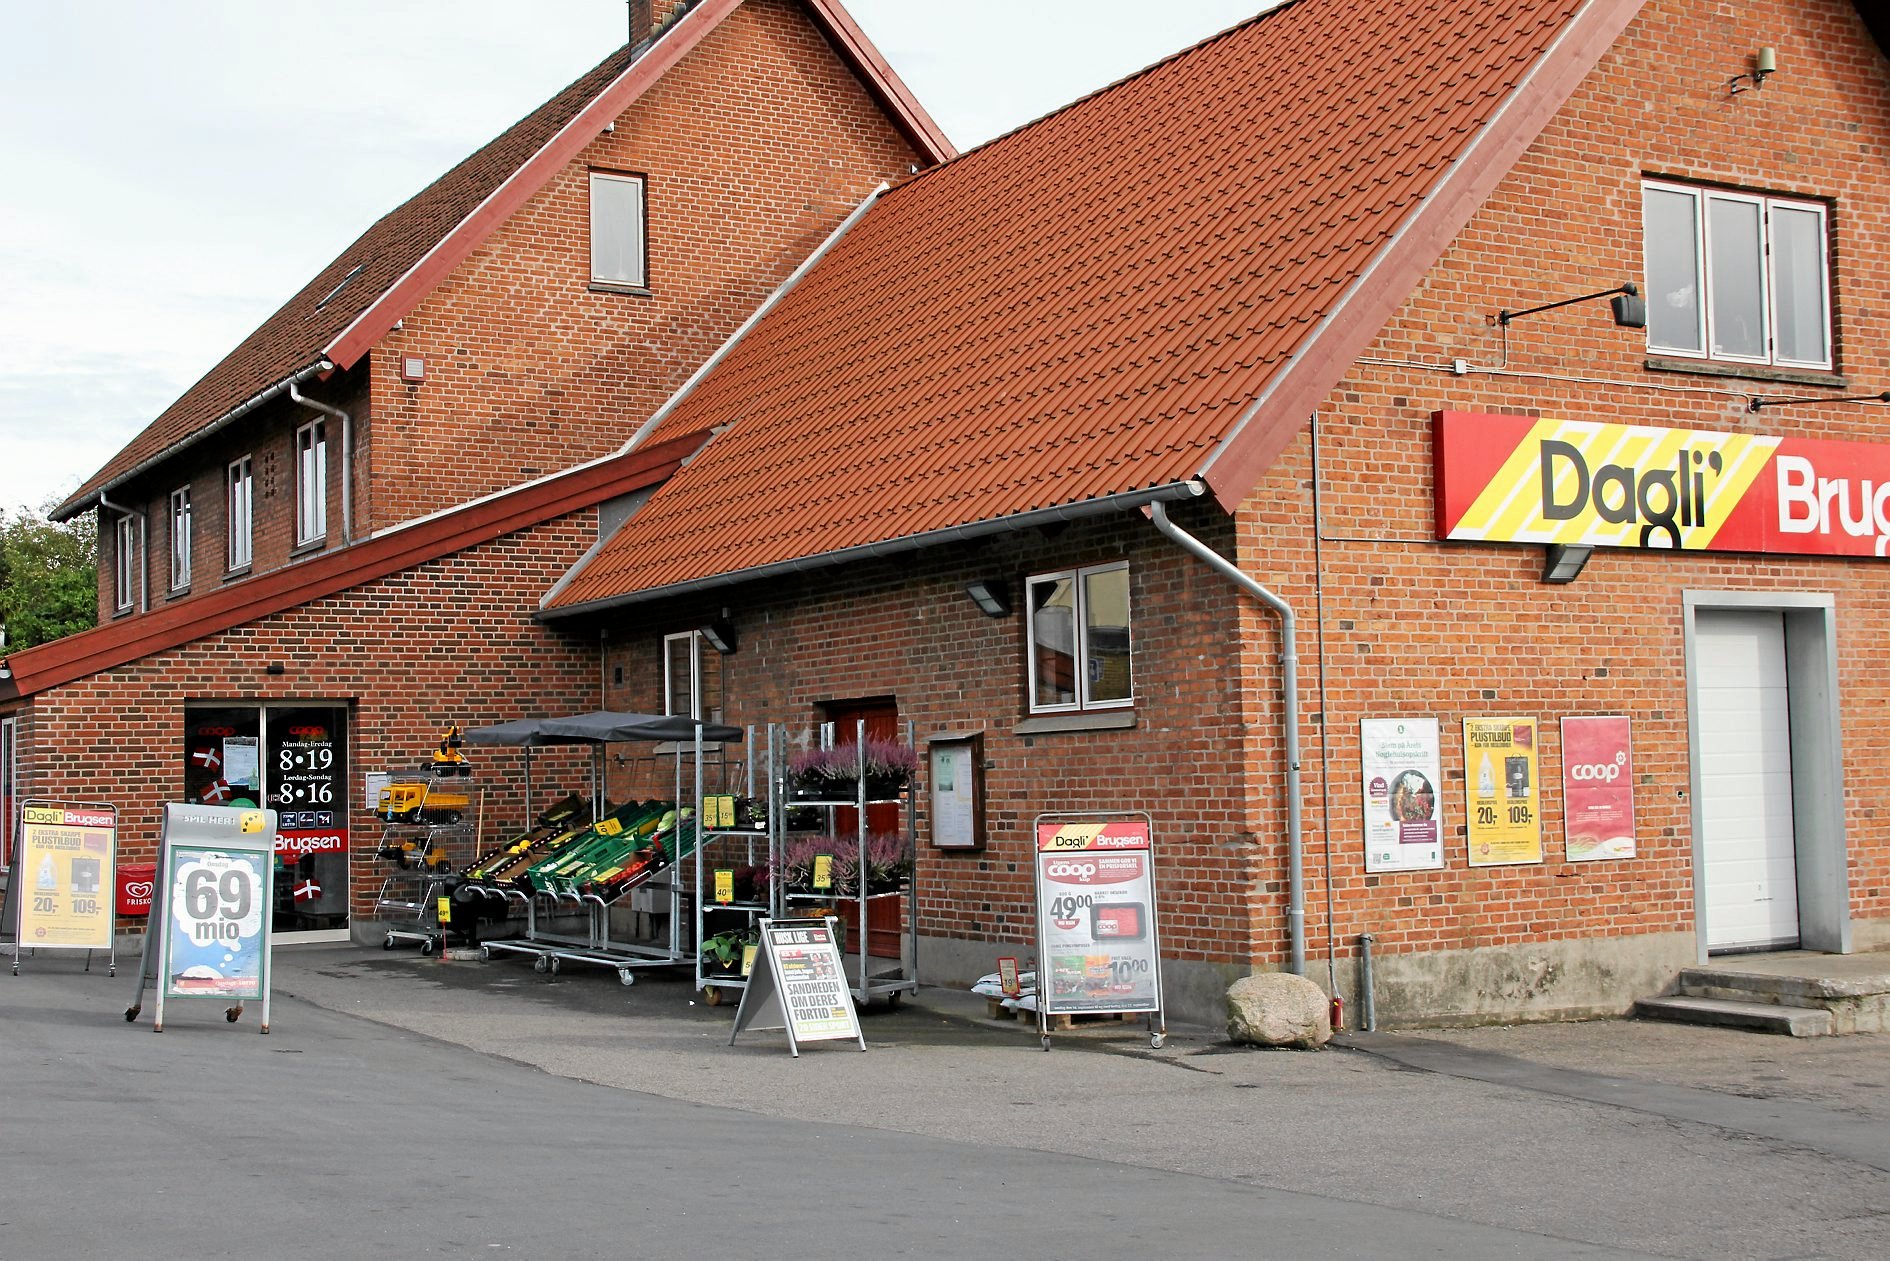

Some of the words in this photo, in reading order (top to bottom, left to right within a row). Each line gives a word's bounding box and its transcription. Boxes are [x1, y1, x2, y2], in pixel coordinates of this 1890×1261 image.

[1470, 731, 1512, 742] PLUSTILBUD
[1571, 763, 1620, 784] coop
[64, 811, 113, 826] Brugsen
[32, 835, 81, 847] PLUSTILBUD
[275, 834, 341, 853] Brugsen
[1096, 834, 1144, 848] Brugsen
[1047, 863, 1096, 877] coop
[185, 869, 251, 920] 69
[195, 917, 240, 940] mio
[787, 981, 840, 995] SANDHEDEN
[790, 995, 808, 1008] OM
[808, 994, 839, 1007] DERES
[794, 1007, 830, 1020] FORTID
